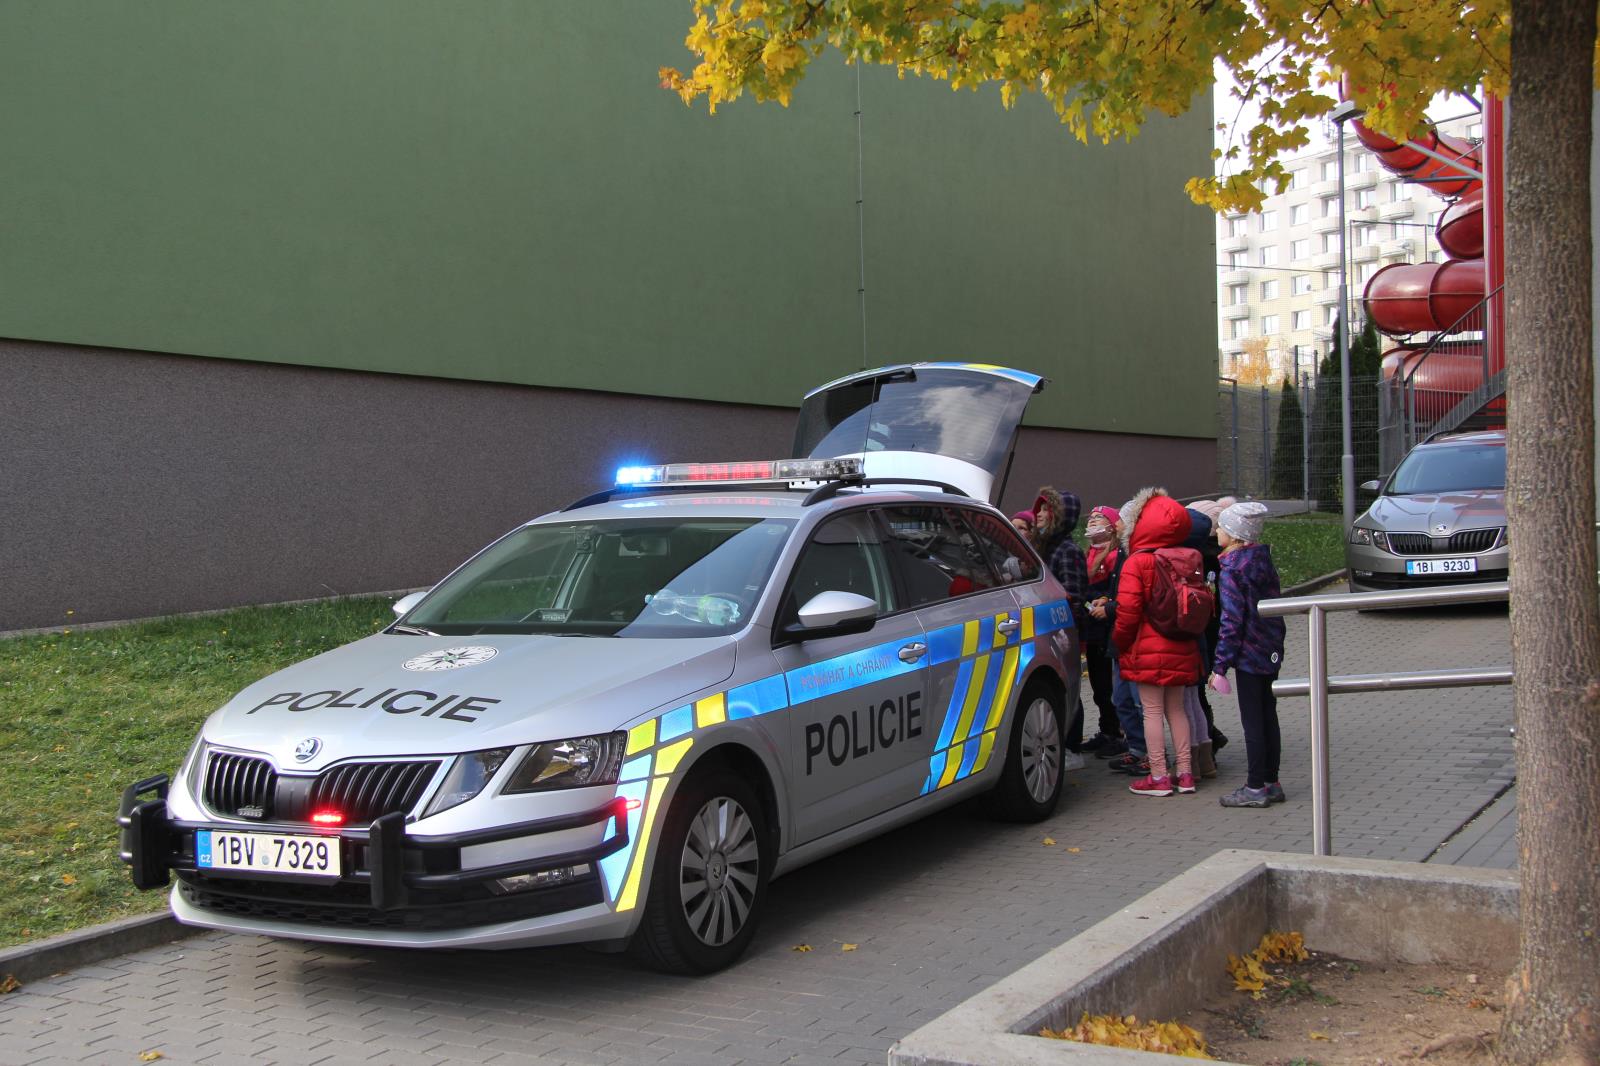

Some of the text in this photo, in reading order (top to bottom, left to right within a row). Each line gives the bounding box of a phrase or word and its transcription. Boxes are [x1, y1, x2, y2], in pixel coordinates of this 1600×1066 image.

[1416, 561, 1434, 572] 1BI
[1443, 560, 1470, 571] 9230
[848, 664, 855, 679] A
[246, 687, 502, 723] POLICIE
[805, 690, 922, 776] POLICIE
[200, 854, 211, 863] CZ
[218, 836, 329, 870] 1BV 7329
